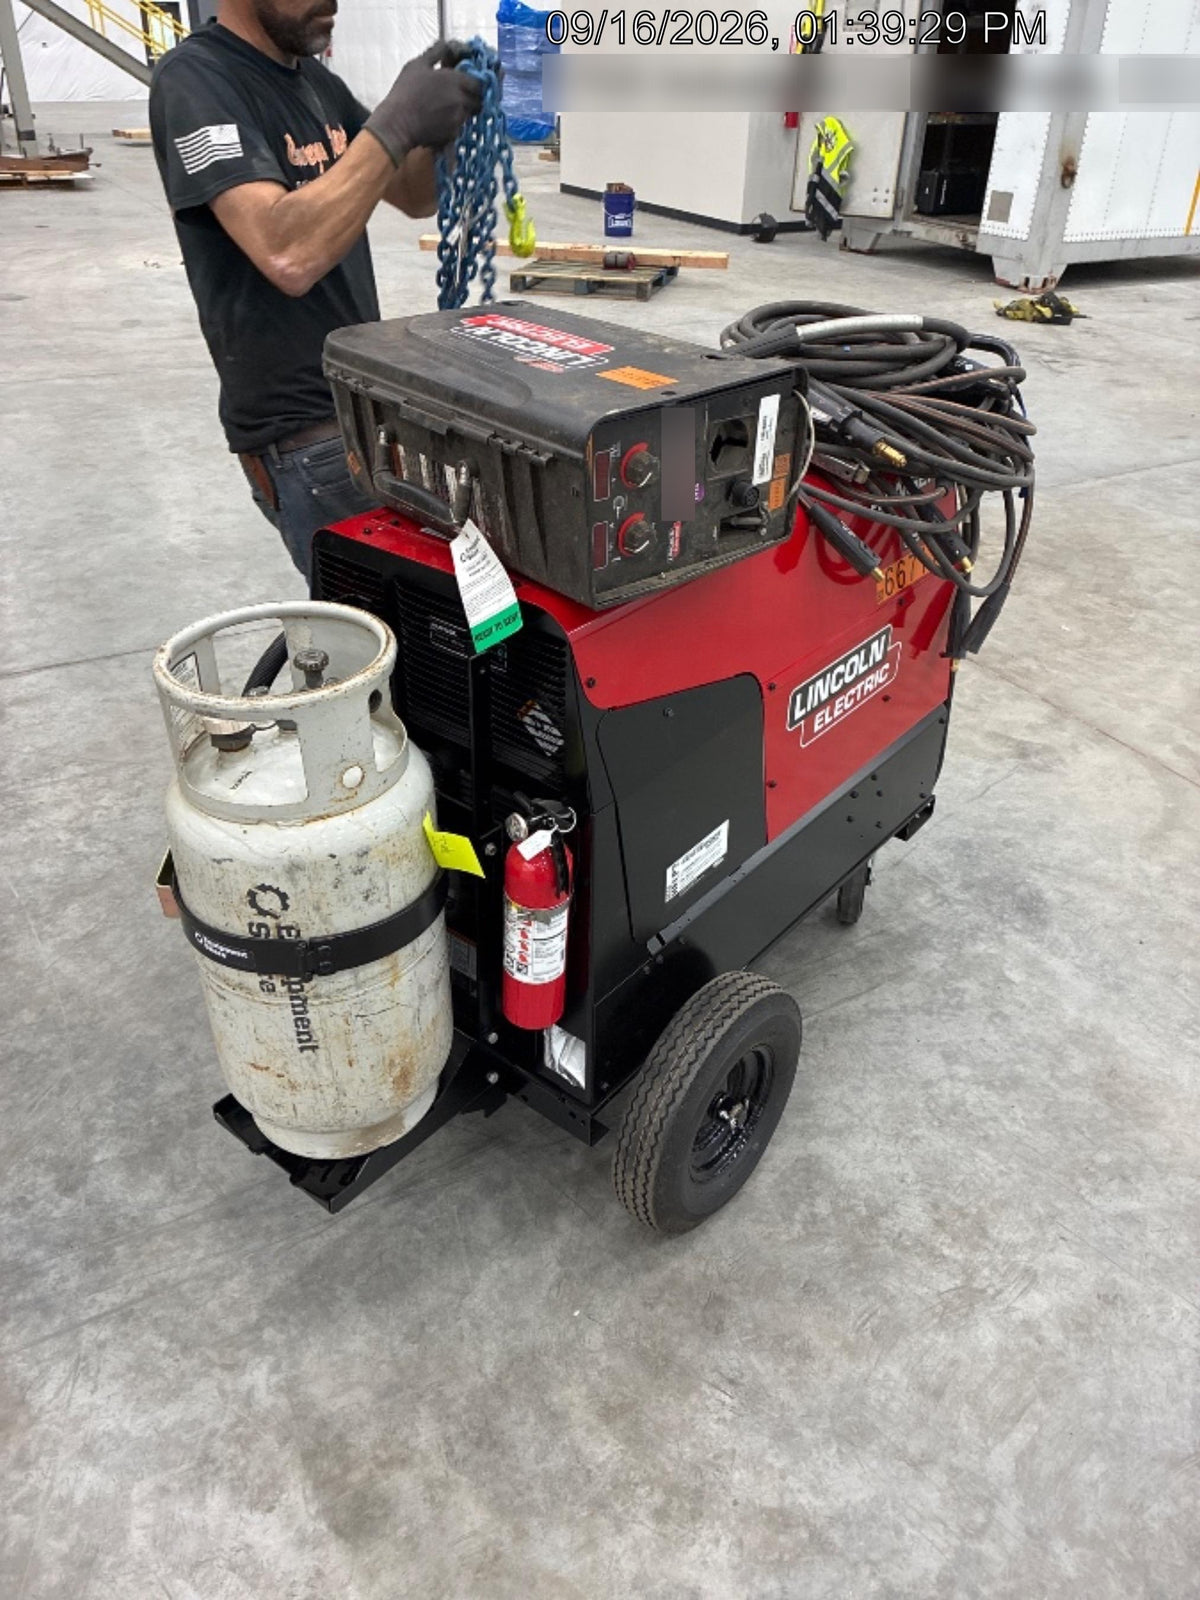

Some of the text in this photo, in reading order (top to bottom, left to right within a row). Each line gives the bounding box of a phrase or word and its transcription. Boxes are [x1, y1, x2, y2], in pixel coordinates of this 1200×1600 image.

[794, 634, 887, 721] LINCOLN
[813, 662, 890, 734] ELECTRIC
[275, 923, 320, 1054] Epment
